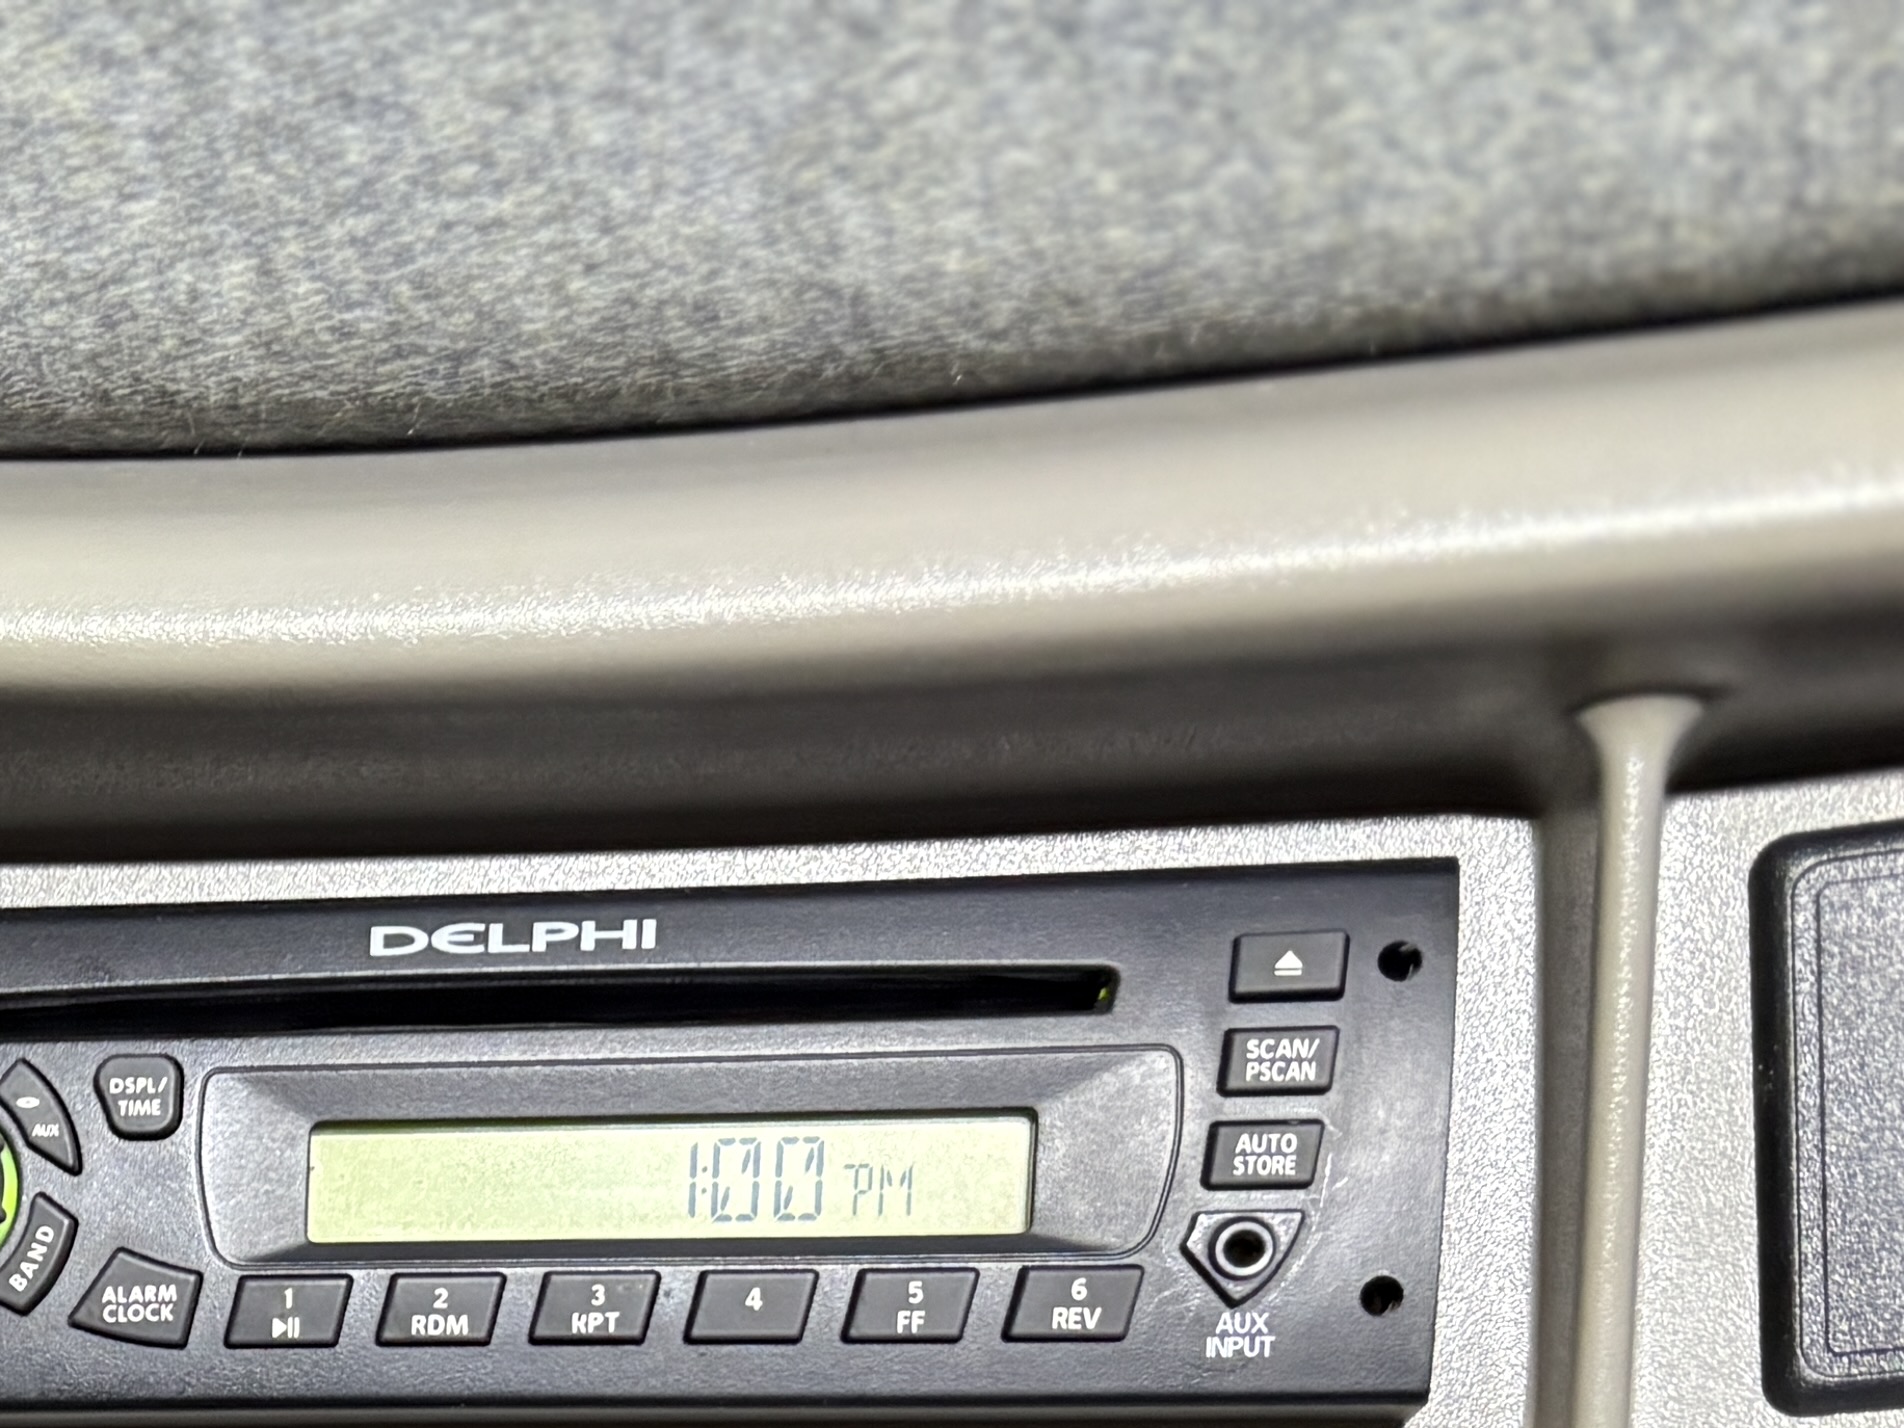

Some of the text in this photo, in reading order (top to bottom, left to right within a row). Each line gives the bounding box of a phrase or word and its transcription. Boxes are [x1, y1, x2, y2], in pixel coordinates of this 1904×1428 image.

[370, 919, 656, 956] DELPHI
[1246, 1038, 1320, 1059] SCAN/
[1245, 1061, 1316, 1082] PSCAN
[109, 1076, 168, 1094] DSPL/
[118, 1099, 161, 1116] TIME
[32, 1122, 59, 1138] AUX
[1235, 1133, 1297, 1154] AUTO
[1233, 1155, 1296, 1175] STORE
[687, 1136, 913, 1222] 1:00 PM
[8, 1224, 56, 1292] BAND
[101, 1284, 177, 1303] ALARM
[283, 1288, 293, 1310] 1
[434, 1288, 449, 1310] 2
[591, 1284, 606, 1306] 3
[744, 1287, 763, 1311] 4
[908, 1281, 923, 1304] 5
[1071, 1278, 1088, 1300] 6
[102, 1302, 175, 1323] CLOCK
[896, 1310, 926, 1334] FF
[1052, 1307, 1102, 1330] REV
[1215, 1312, 1270, 1334] AUX
[410, 1315, 469, 1336] RDM
[1205, 1336, 1276, 1358] INPUT
